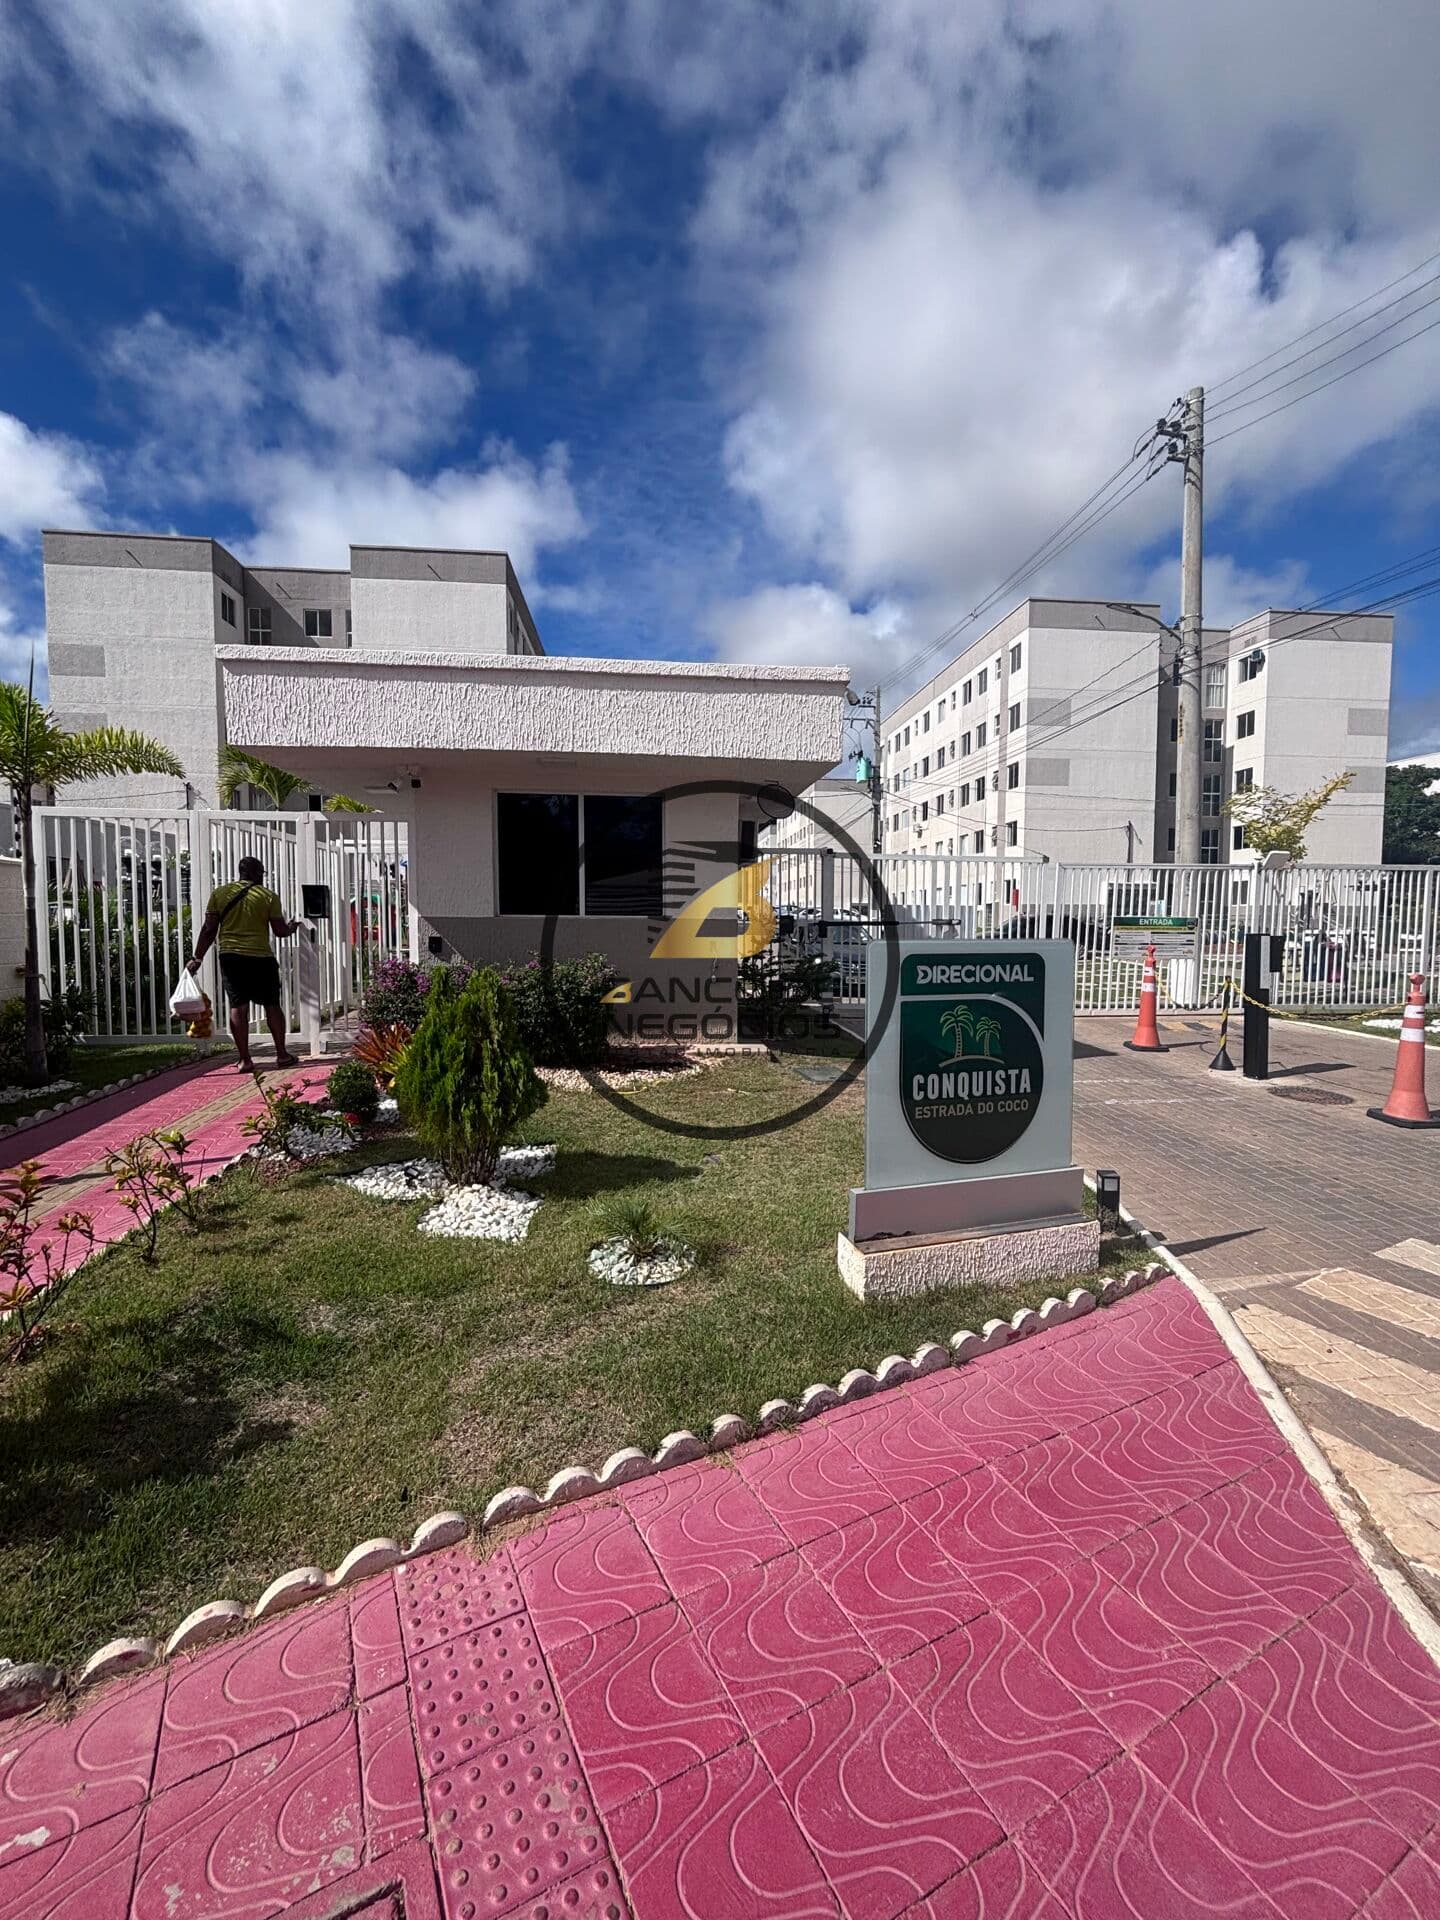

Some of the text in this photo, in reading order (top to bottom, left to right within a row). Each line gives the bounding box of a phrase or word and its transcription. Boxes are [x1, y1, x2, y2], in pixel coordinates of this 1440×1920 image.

[1139, 918, 1173, 926] ENTRADA
[916, 964, 1035, 984] DIRECIONAL
[912, 1068, 1032, 1101] CONQUISTA
[915, 1099, 1029, 1119] ESTRADA DO COCO
